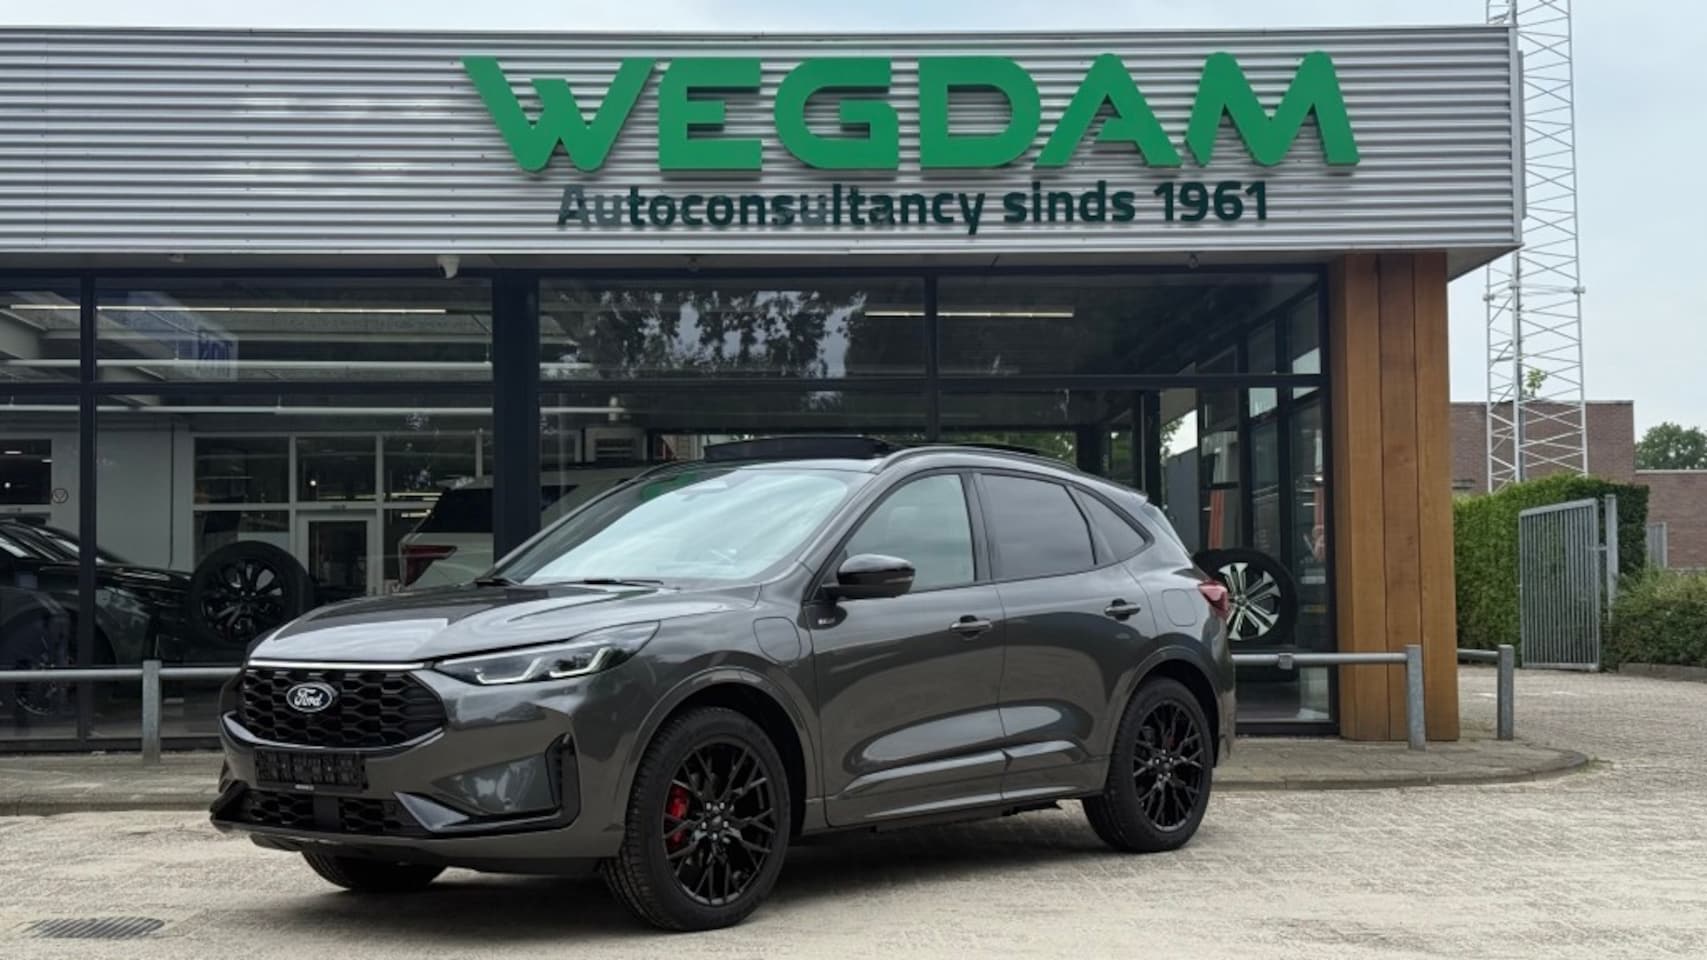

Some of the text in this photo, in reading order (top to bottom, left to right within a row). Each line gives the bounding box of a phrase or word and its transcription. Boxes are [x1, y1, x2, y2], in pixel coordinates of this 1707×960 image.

[462, 50, 1361, 172] WEGDAM
[557, 180, 1267, 236] Autoconsultancy sinds 1961
[294, 687, 323, 706] Ford
